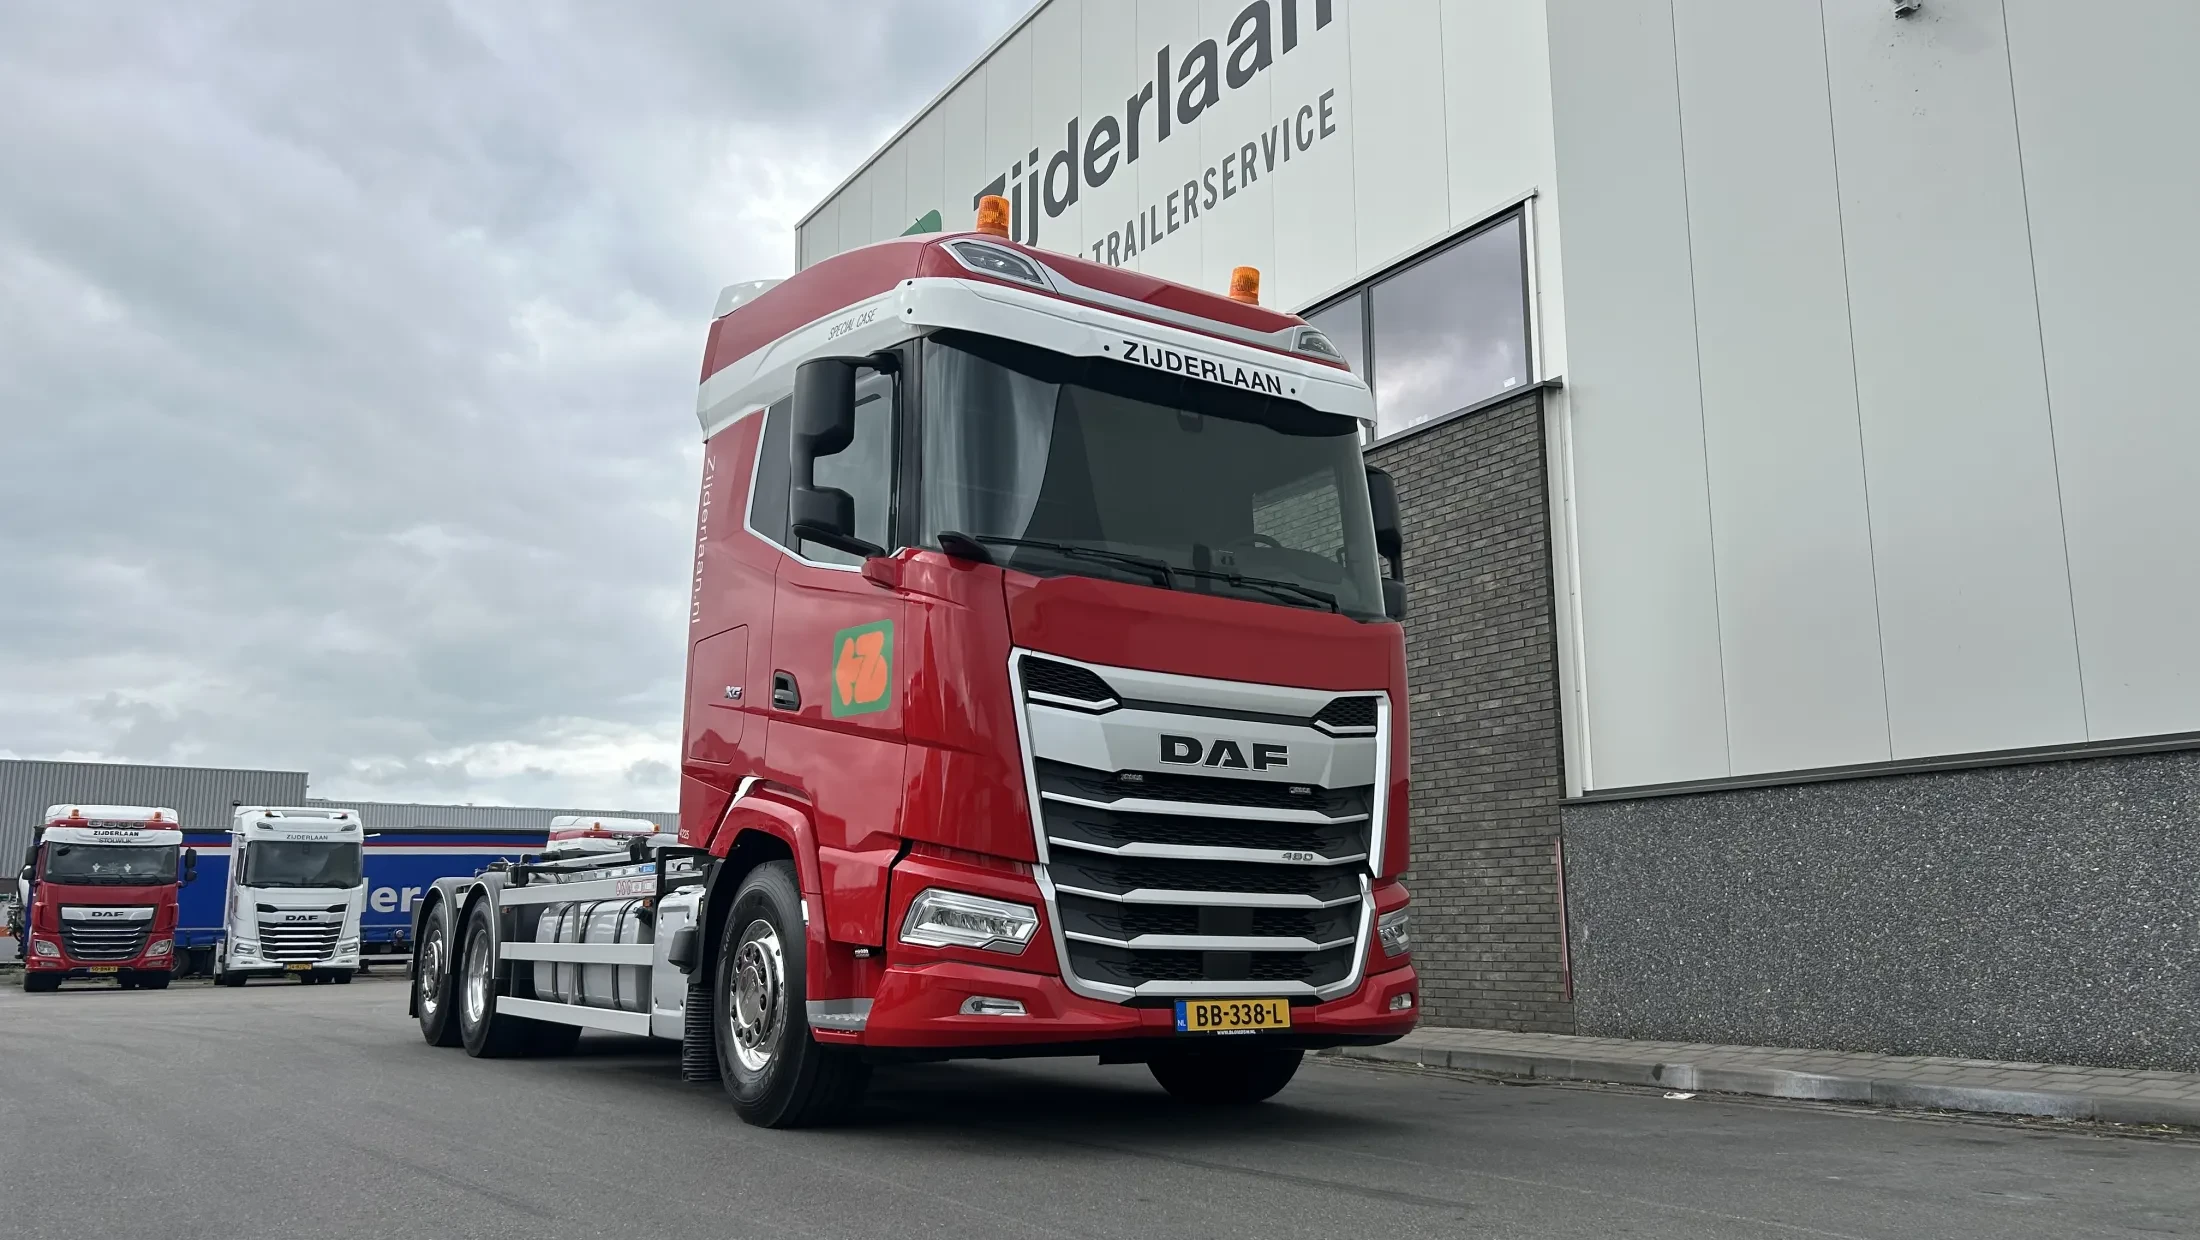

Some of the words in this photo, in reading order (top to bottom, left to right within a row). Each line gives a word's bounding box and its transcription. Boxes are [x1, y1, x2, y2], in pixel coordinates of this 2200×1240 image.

[1092, 88, 1336, 268] TRAILERSERVICE
[828, 317, 855, 341] SPECIAL
[856, 307, 878, 328] CASE
[1122, 339, 1283, 396] ZIJDERLAAN
[691, 455, 716, 623] Zijderlaan.nl
[1159, 732, 1289, 771] DAF
[1281, 852, 1313, 861] 480
[1177, 1019, 1187, 1027] NL
[1196, 1003, 1284, 1027] BB-338-L
